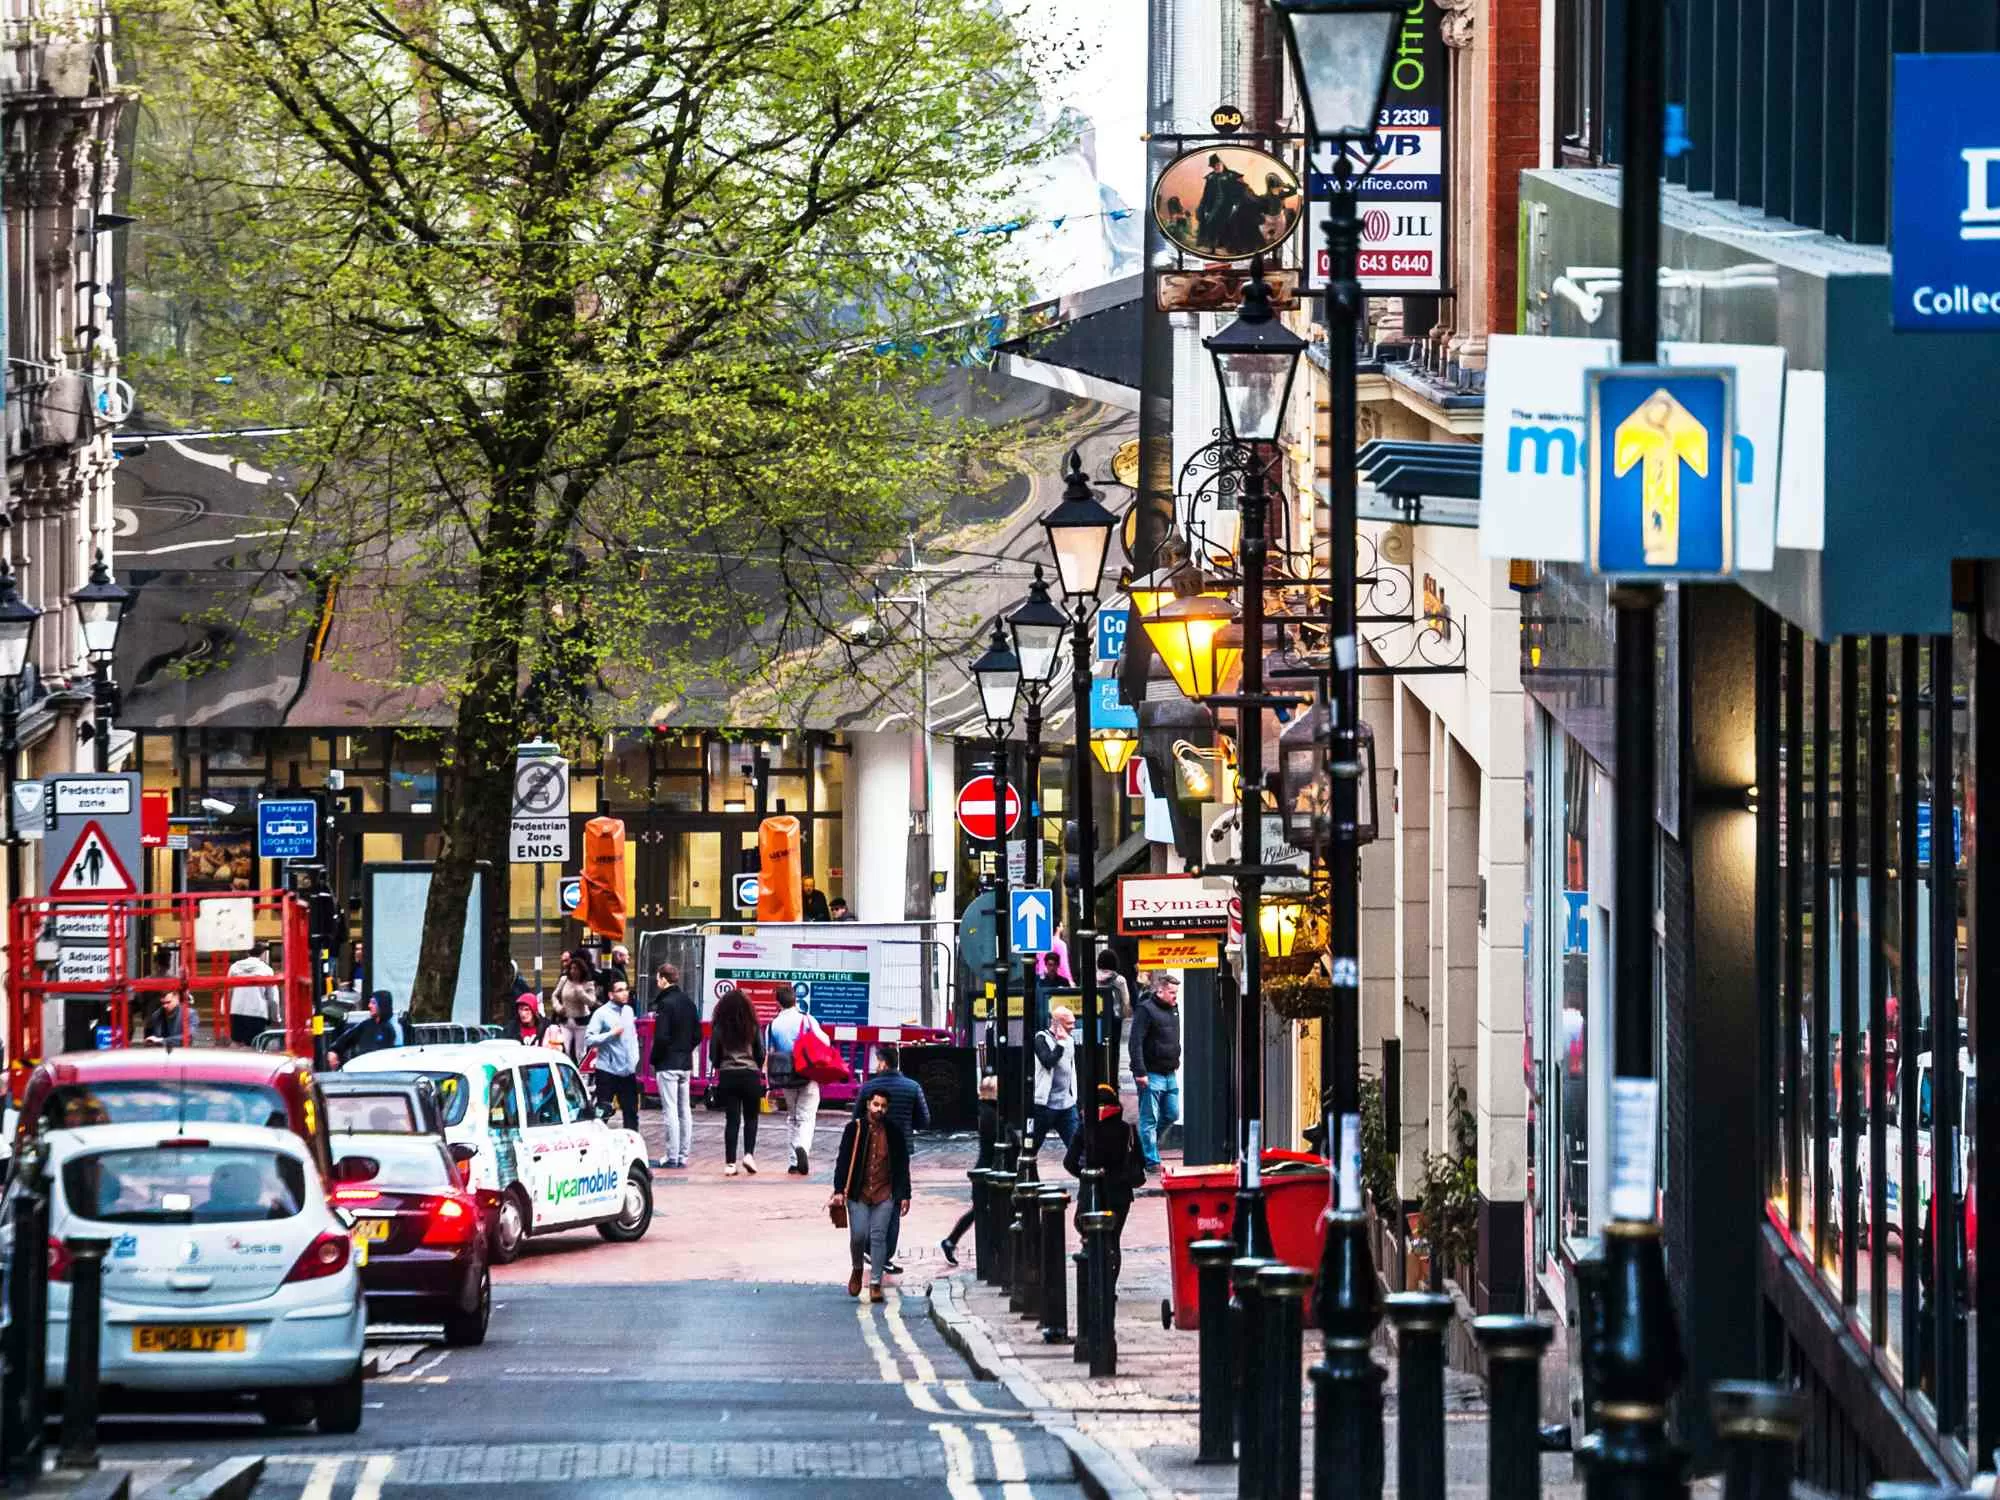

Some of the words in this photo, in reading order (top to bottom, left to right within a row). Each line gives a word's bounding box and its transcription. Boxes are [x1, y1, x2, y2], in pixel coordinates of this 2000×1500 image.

[1392, 109, 1429, 125] 2330
[1392, 215, 1433, 237] JLL
[1359, 254, 1388, 271] 643
[1391, 254, 1429, 271] 6440
[59, 785, 125, 796] Pedestrian
[77, 799, 106, 808] zone
[266, 805, 309, 813] TRAMWAY
[512, 821, 567, 832] Pedestrian
[263, 837, 286, 845] LOOK
[288, 837, 313, 845] BOTH
[526, 832, 553, 842] Zone
[275, 846, 300, 854] WAYS
[517, 844, 564, 858] ENDS
[1129, 919, 1154, 928] the
[1162, 918, 1227, 927] statione
[1157, 945, 1198, 957] DHL
[68, 952, 110, 963] Advisor
[96, 965, 123, 976] limt
[731, 968, 752, 978] SITE
[753, 970, 790, 980] SAFETY
[791, 972, 826, 981] STARTS
[828, 973, 853, 981] HERE
[547, 1163, 618, 1206] Lycamobile
